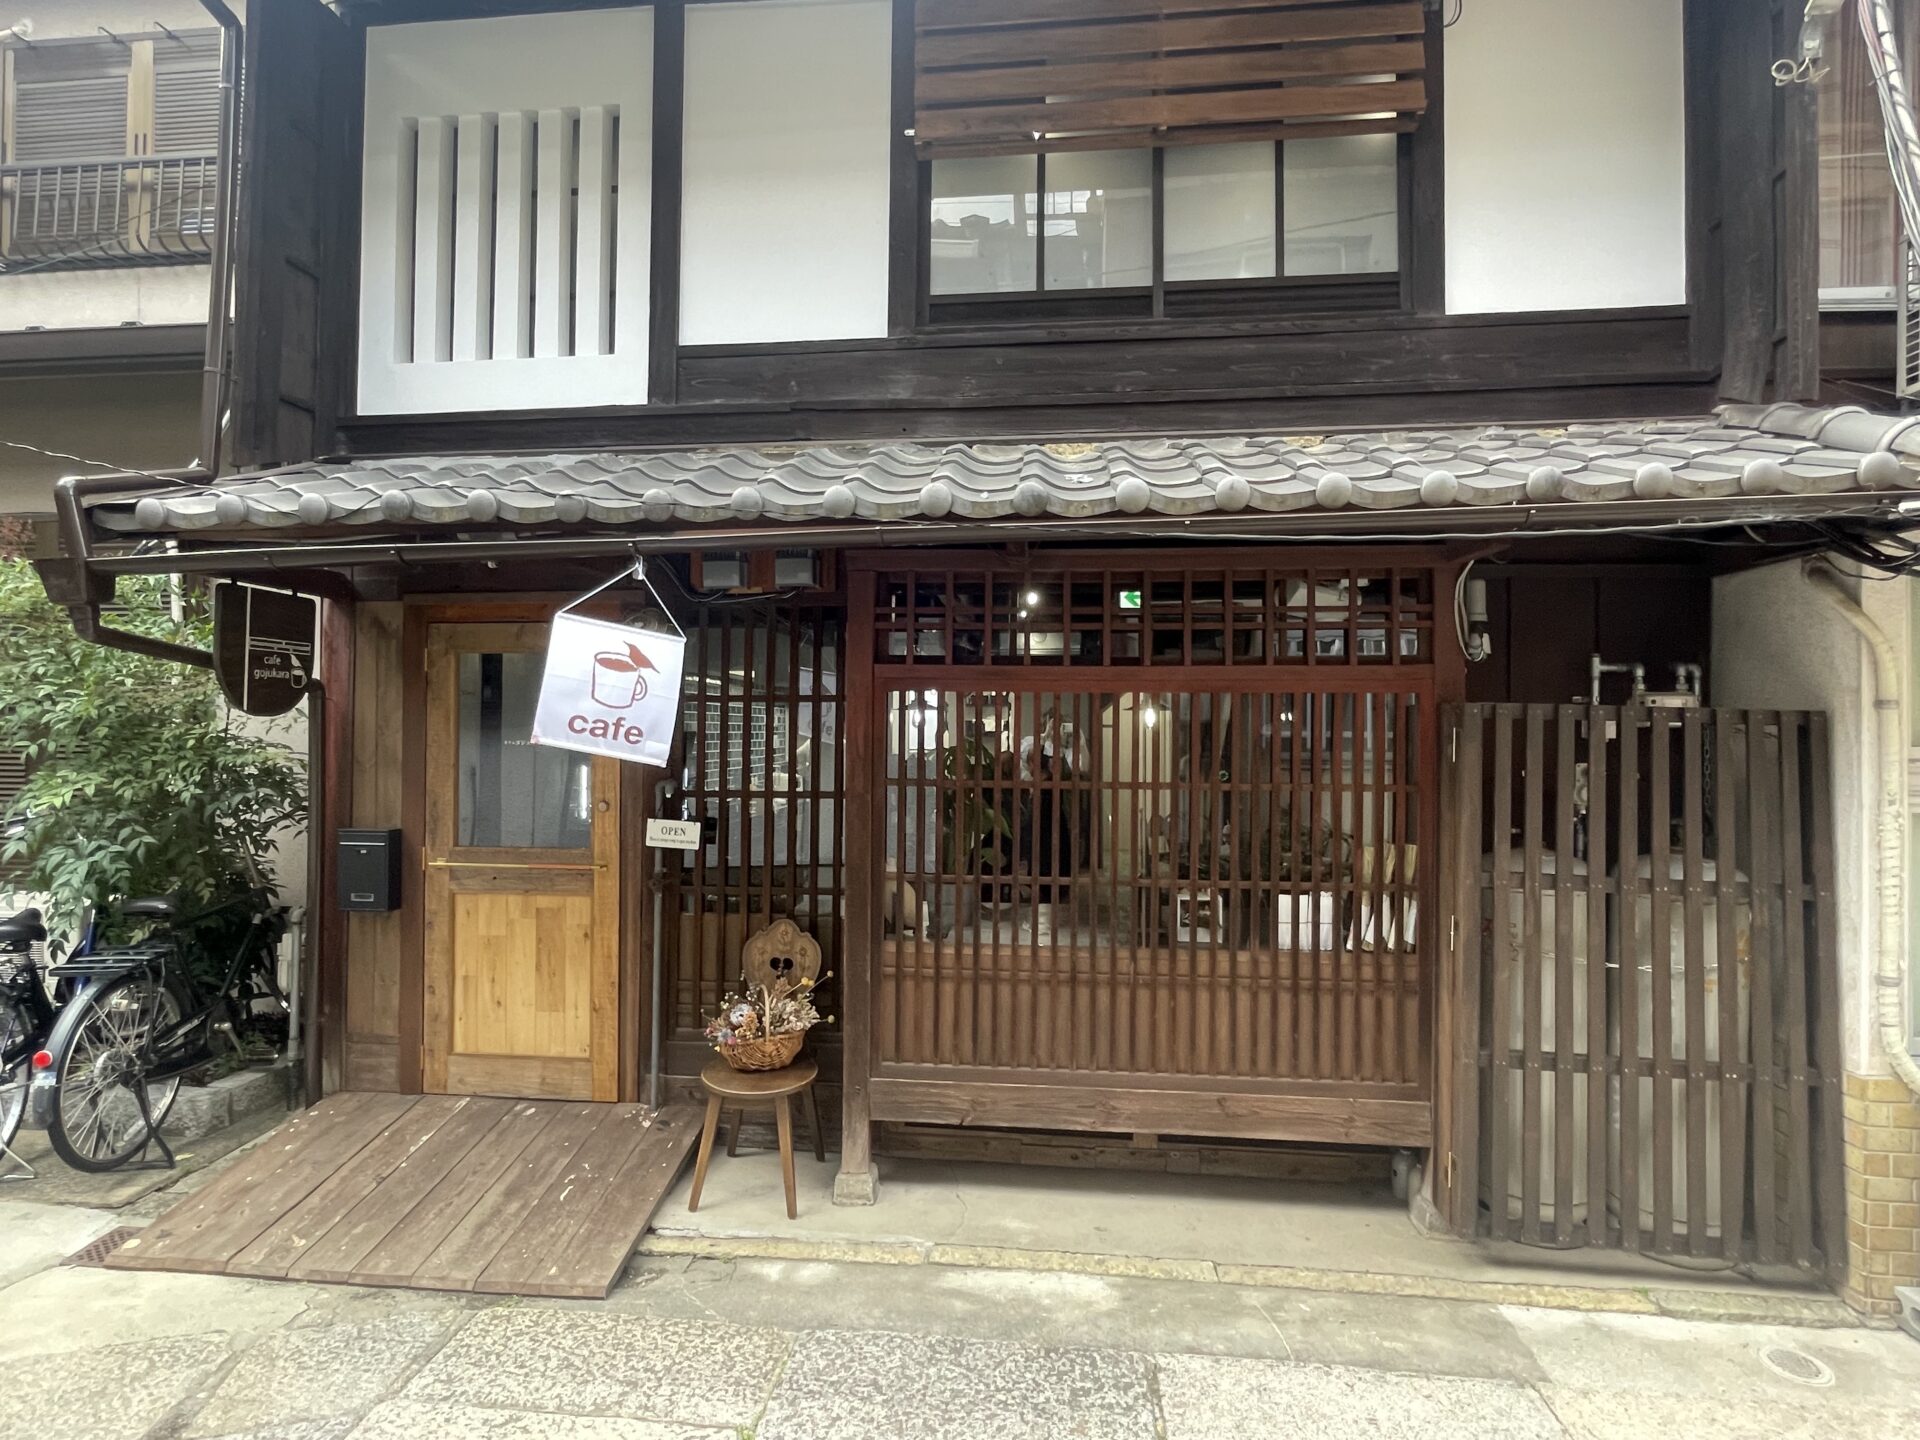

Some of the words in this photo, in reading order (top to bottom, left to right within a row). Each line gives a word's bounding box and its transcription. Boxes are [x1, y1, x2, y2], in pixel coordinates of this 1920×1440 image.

[263, 654, 282, 665] cafe
[253, 667, 290, 680] gojukara
[567, 714, 644, 745] cafe
[660, 826, 687, 837] OPEN
